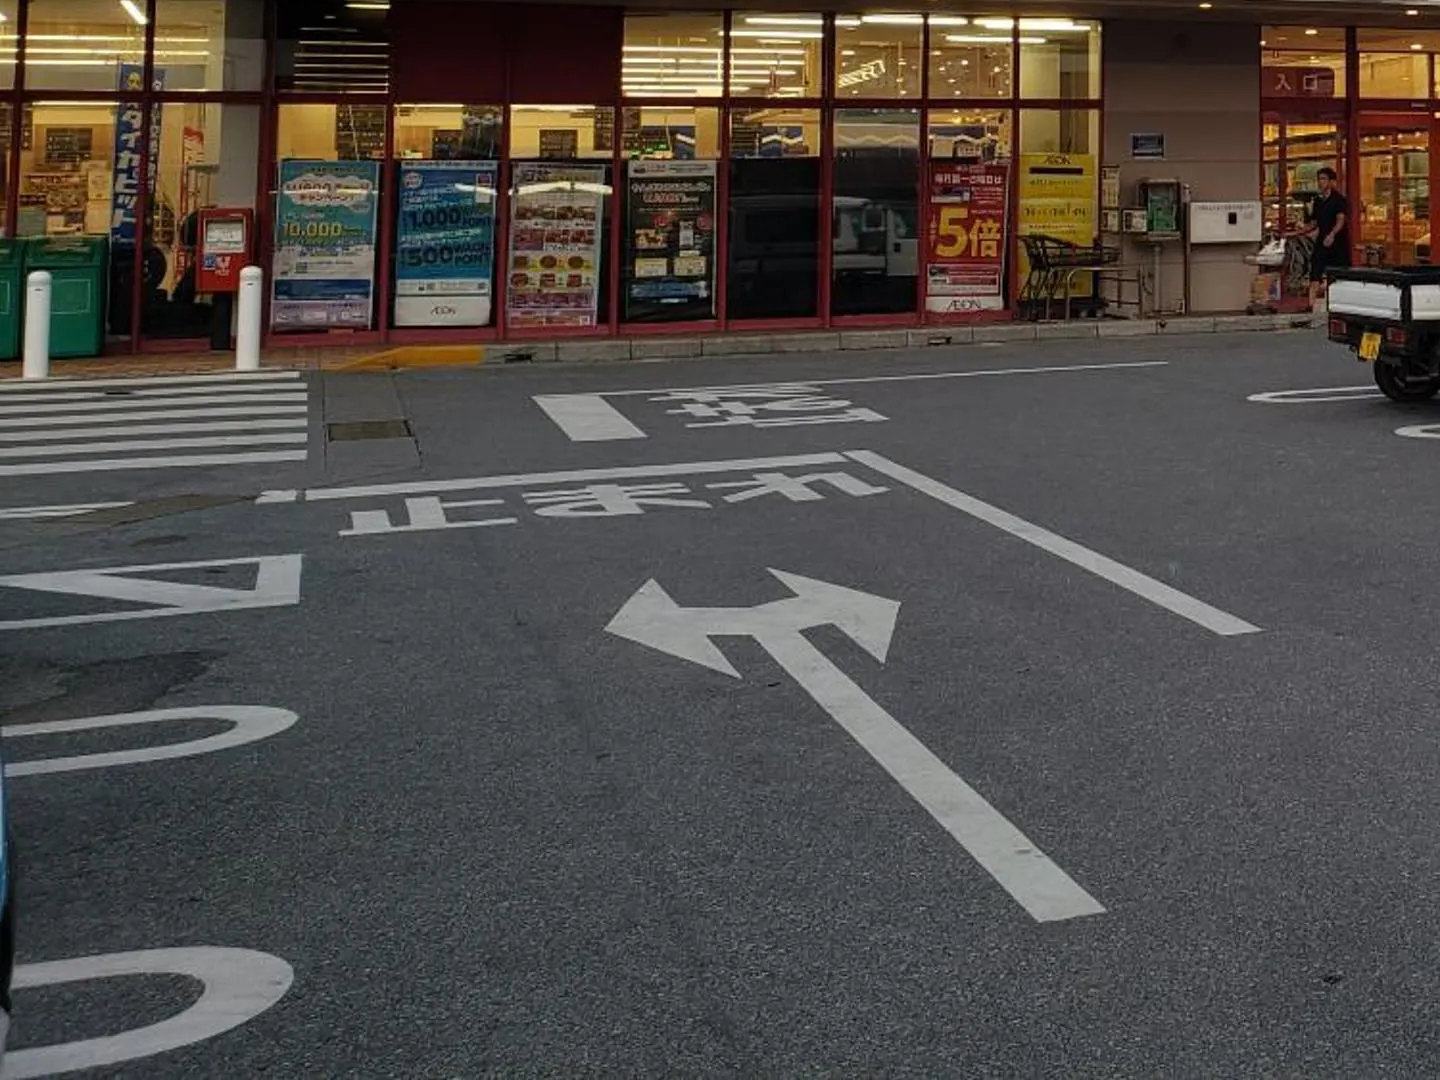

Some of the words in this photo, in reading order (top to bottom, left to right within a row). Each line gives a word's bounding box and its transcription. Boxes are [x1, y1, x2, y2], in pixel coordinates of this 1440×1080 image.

[1275, 73, 1318, 91] 入口
[935, 207, 1002, 258] 5倍
[338, 471, 892, 537] 止まれ
